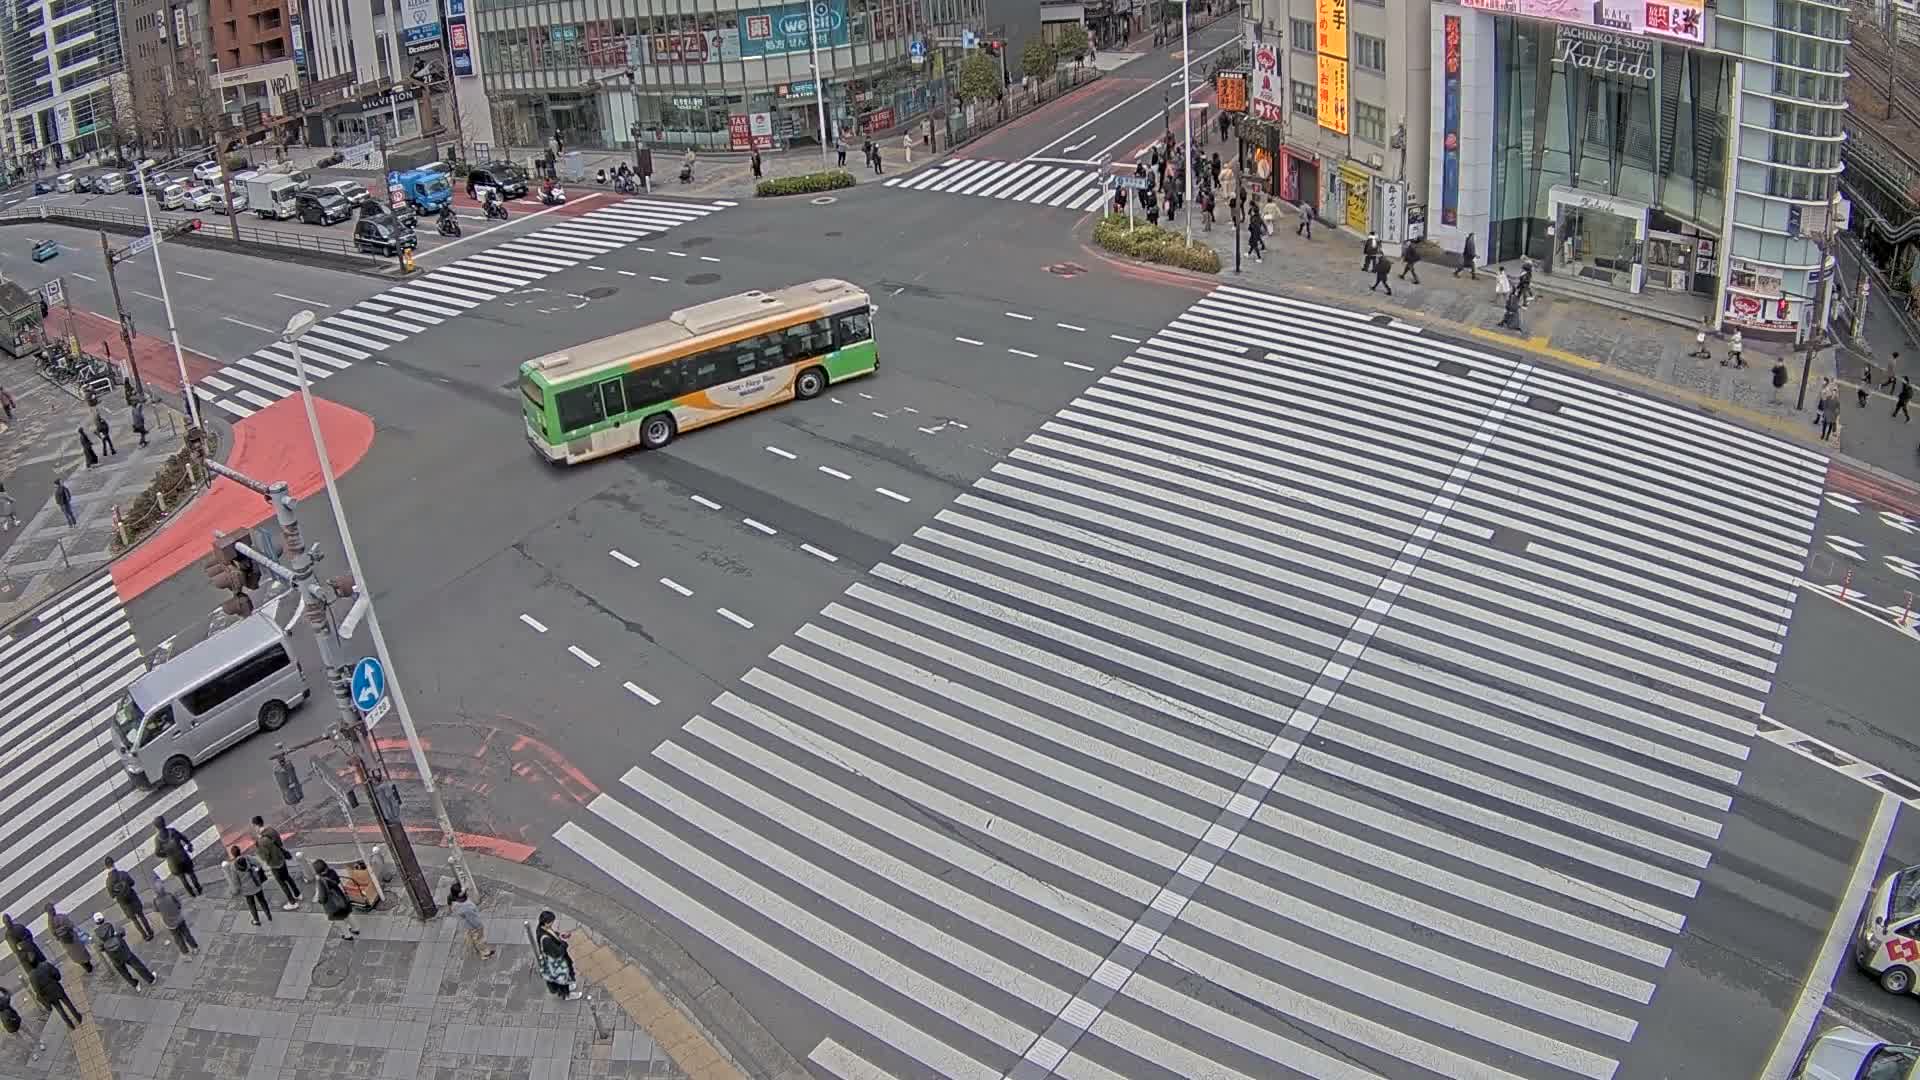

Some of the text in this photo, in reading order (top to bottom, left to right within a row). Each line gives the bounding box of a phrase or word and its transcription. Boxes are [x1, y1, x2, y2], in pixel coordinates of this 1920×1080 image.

[1557, 25, 1613, 44] PACHINKO
[1624, 38, 1650, 53] SLOT
[1551, 38, 1656, 80] Kaleido
[731, 117, 746, 125] TAX
